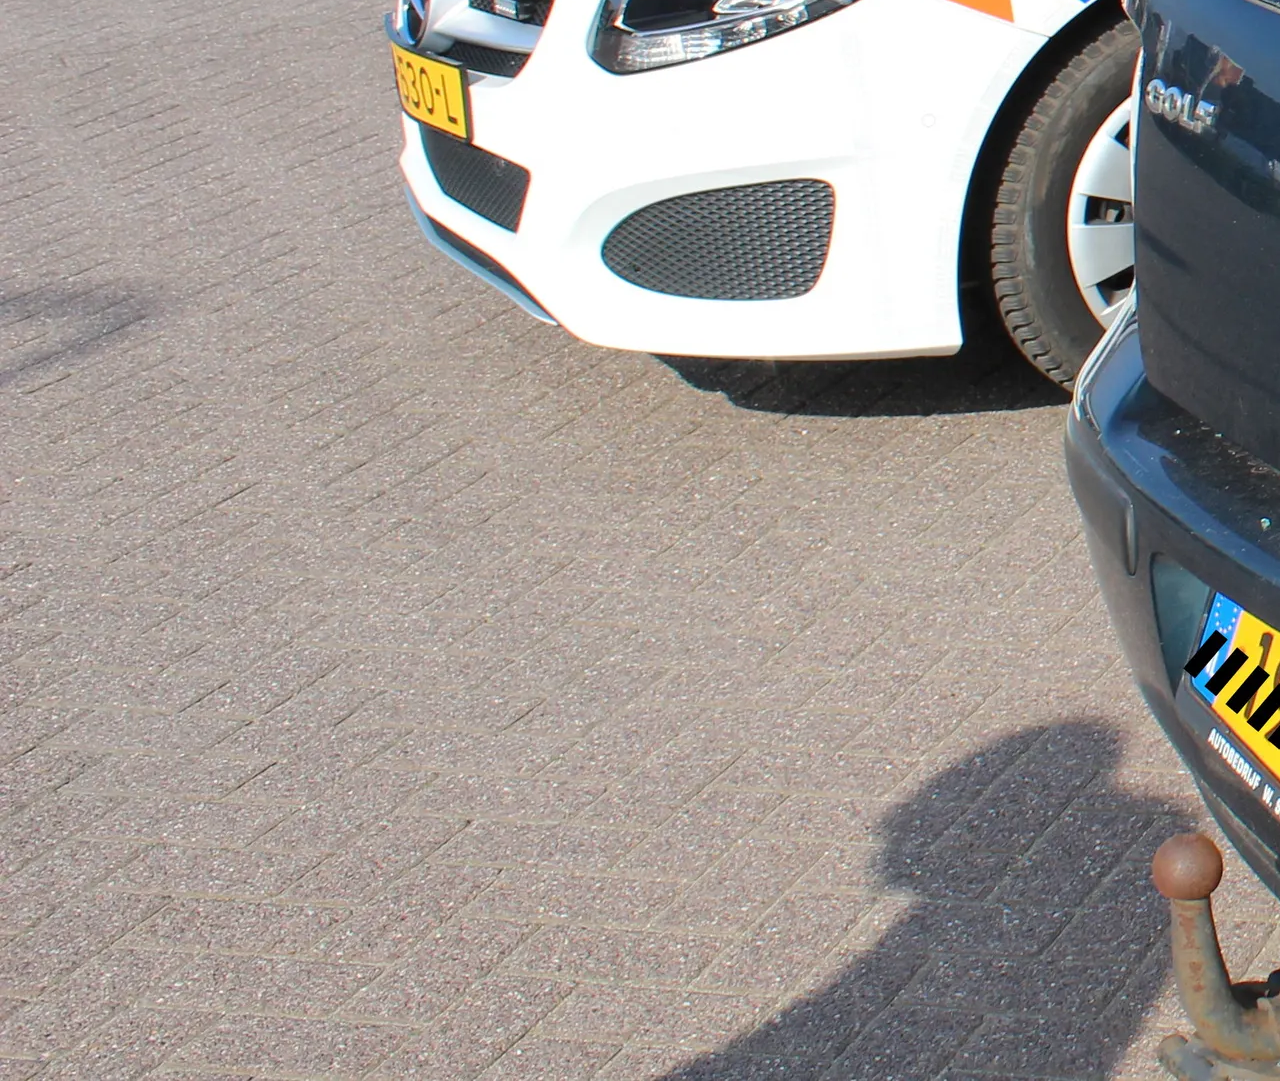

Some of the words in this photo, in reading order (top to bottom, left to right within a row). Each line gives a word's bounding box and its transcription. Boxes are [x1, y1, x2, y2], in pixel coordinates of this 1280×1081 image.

[1145, 79, 1216, 134] GOLF
[1207, 727, 1262, 791] AUTOBEDRIJF
[1262, 785, 1273, 807] W.
